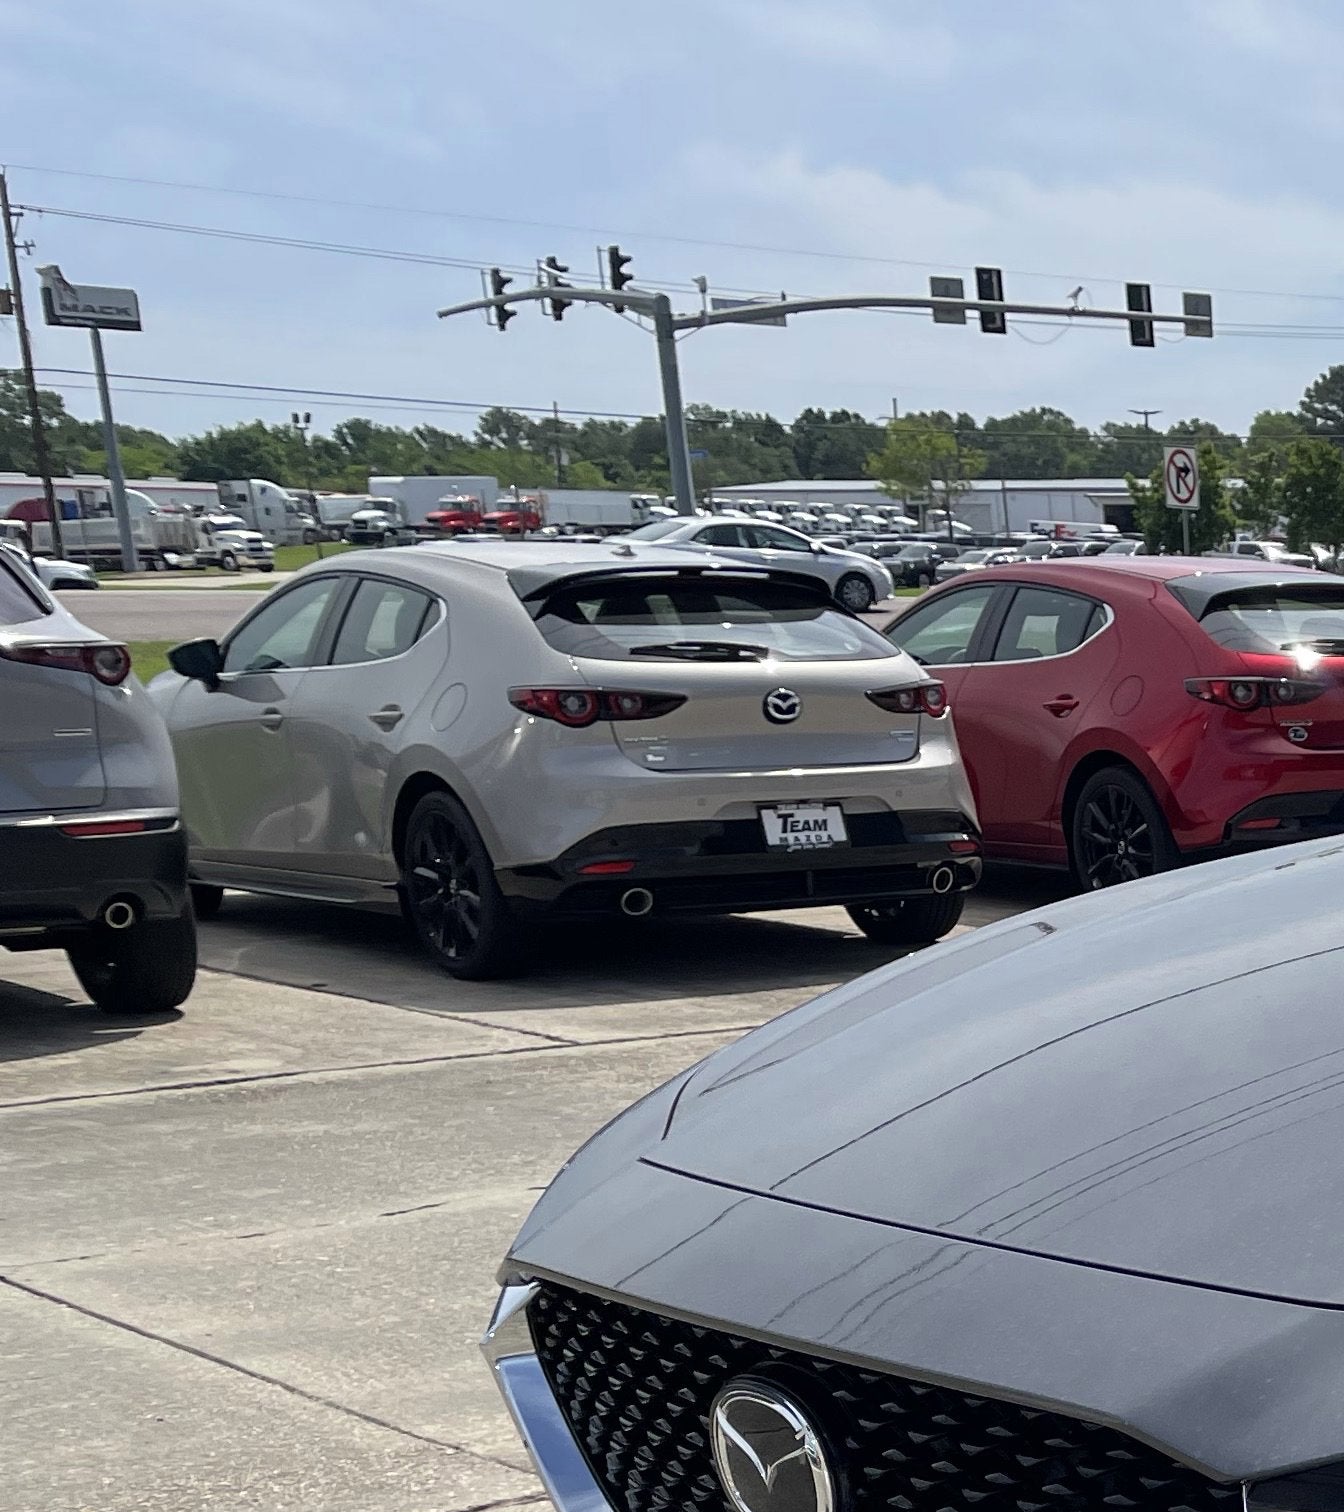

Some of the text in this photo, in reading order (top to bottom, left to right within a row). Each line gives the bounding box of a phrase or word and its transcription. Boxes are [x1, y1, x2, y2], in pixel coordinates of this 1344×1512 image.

[60, 303, 132, 316] MACK
[777, 813, 828, 834] TEAM
[779, 834, 834, 845] MAZDA
